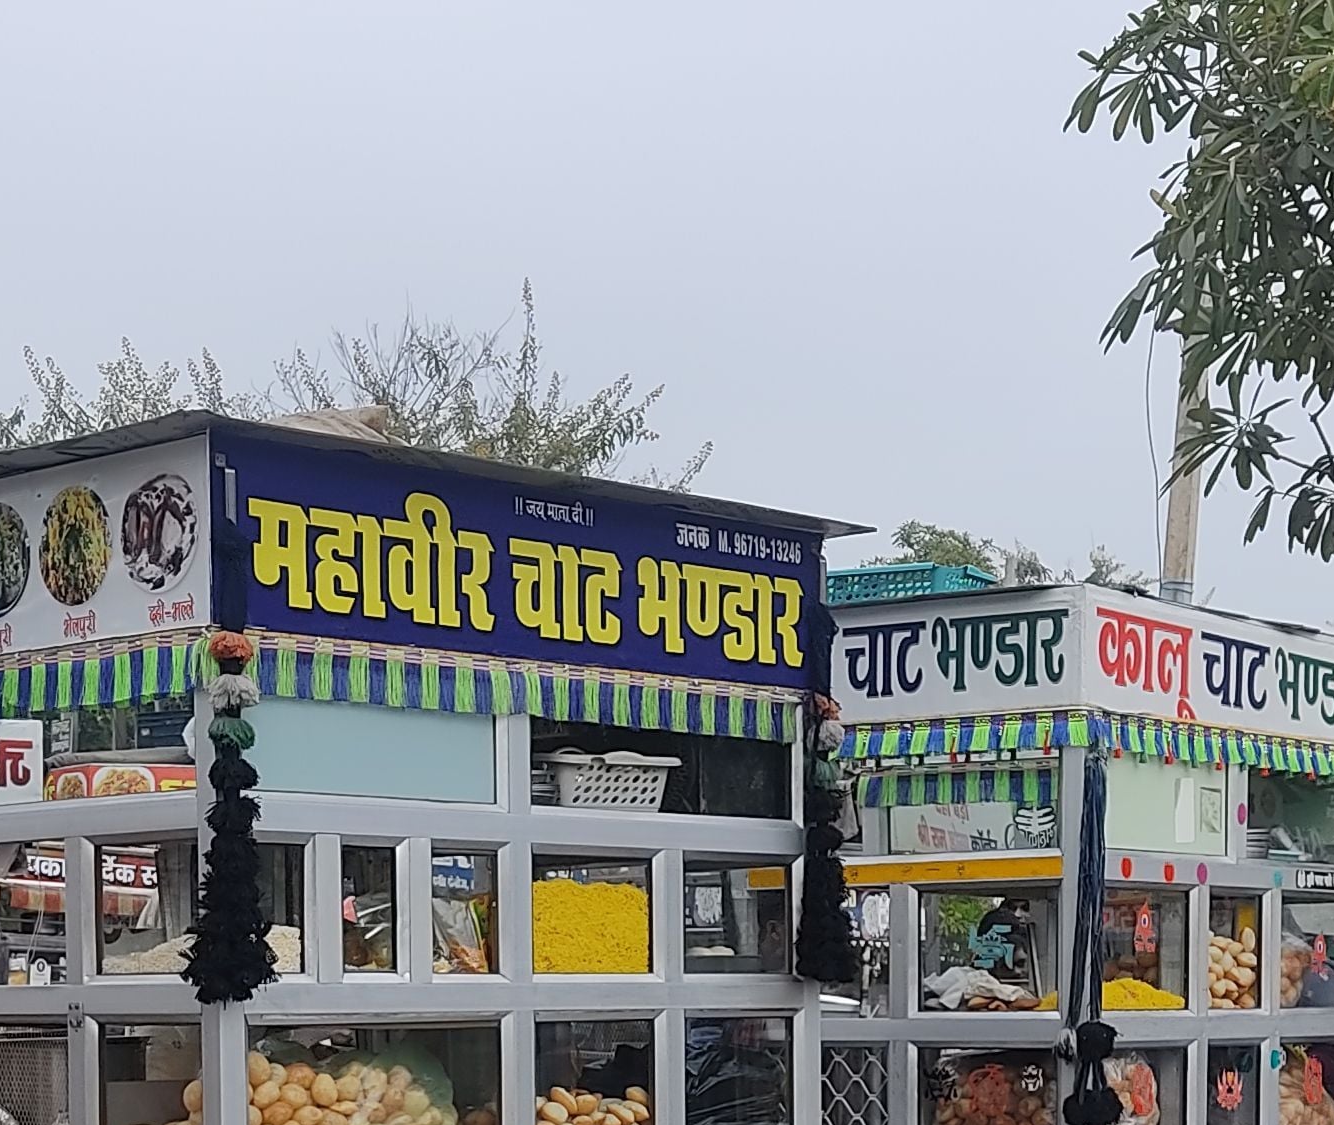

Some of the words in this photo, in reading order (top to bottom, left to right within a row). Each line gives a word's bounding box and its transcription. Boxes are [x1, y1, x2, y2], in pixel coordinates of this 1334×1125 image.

[248, 492, 496, 632] महावीर
[509, 537, 623, 645] चाट
[637, 556, 806, 668] भण्डार
[676, 522, 710, 550] जनक
[718, 530, 731, 553] M.
[734, 534, 802, 565] 96719-13246
[842, 620, 927, 699] चाट
[932, 608, 1069, 693] भण्डार
[1096, 607, 1197, 721] कालू
[1201, 630, 1271, 711] चाट
